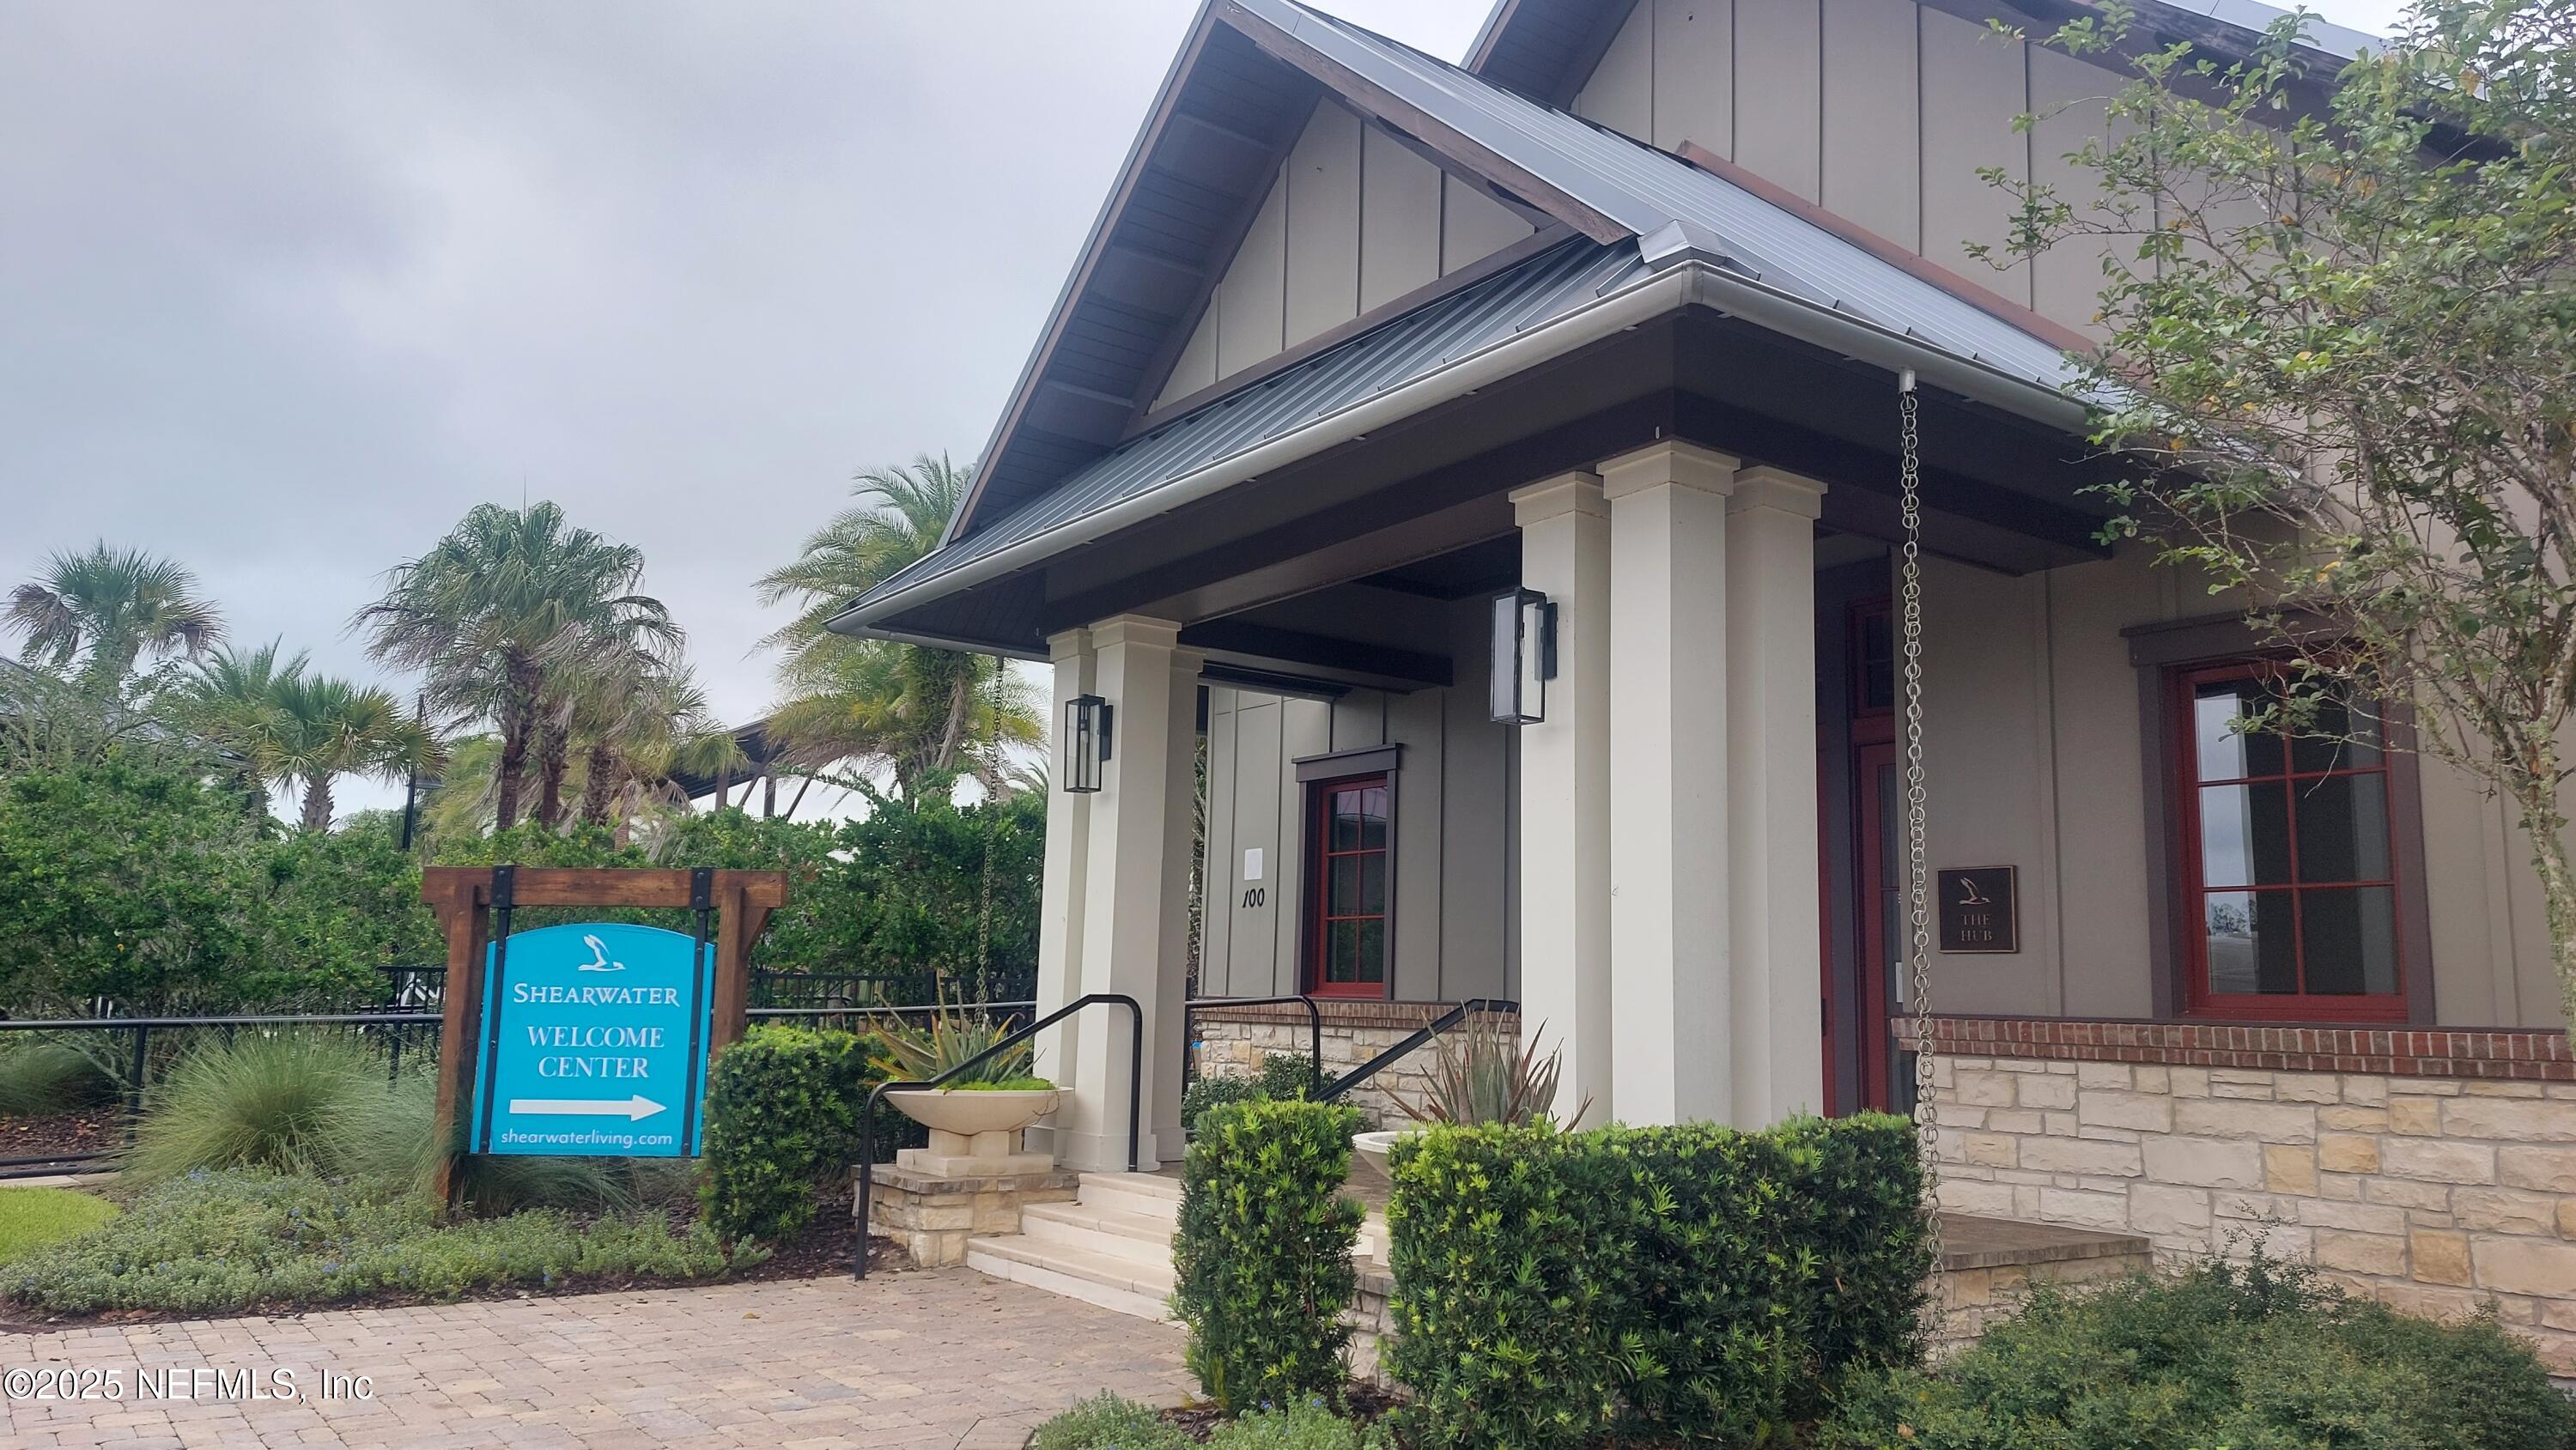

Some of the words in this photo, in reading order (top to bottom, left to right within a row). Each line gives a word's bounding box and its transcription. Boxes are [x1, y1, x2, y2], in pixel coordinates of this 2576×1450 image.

[1242, 888, 1265, 907] 100
[1960, 913, 1991, 925] THE
[1961, 930, 1993, 942] HUB
[513, 982, 681, 1007] SHEARWATER
[527, 1025, 665, 1048] WELCOME
[538, 1056, 649, 1078] CENTER
[501, 1128, 672, 1149] shearwaterliving.com
